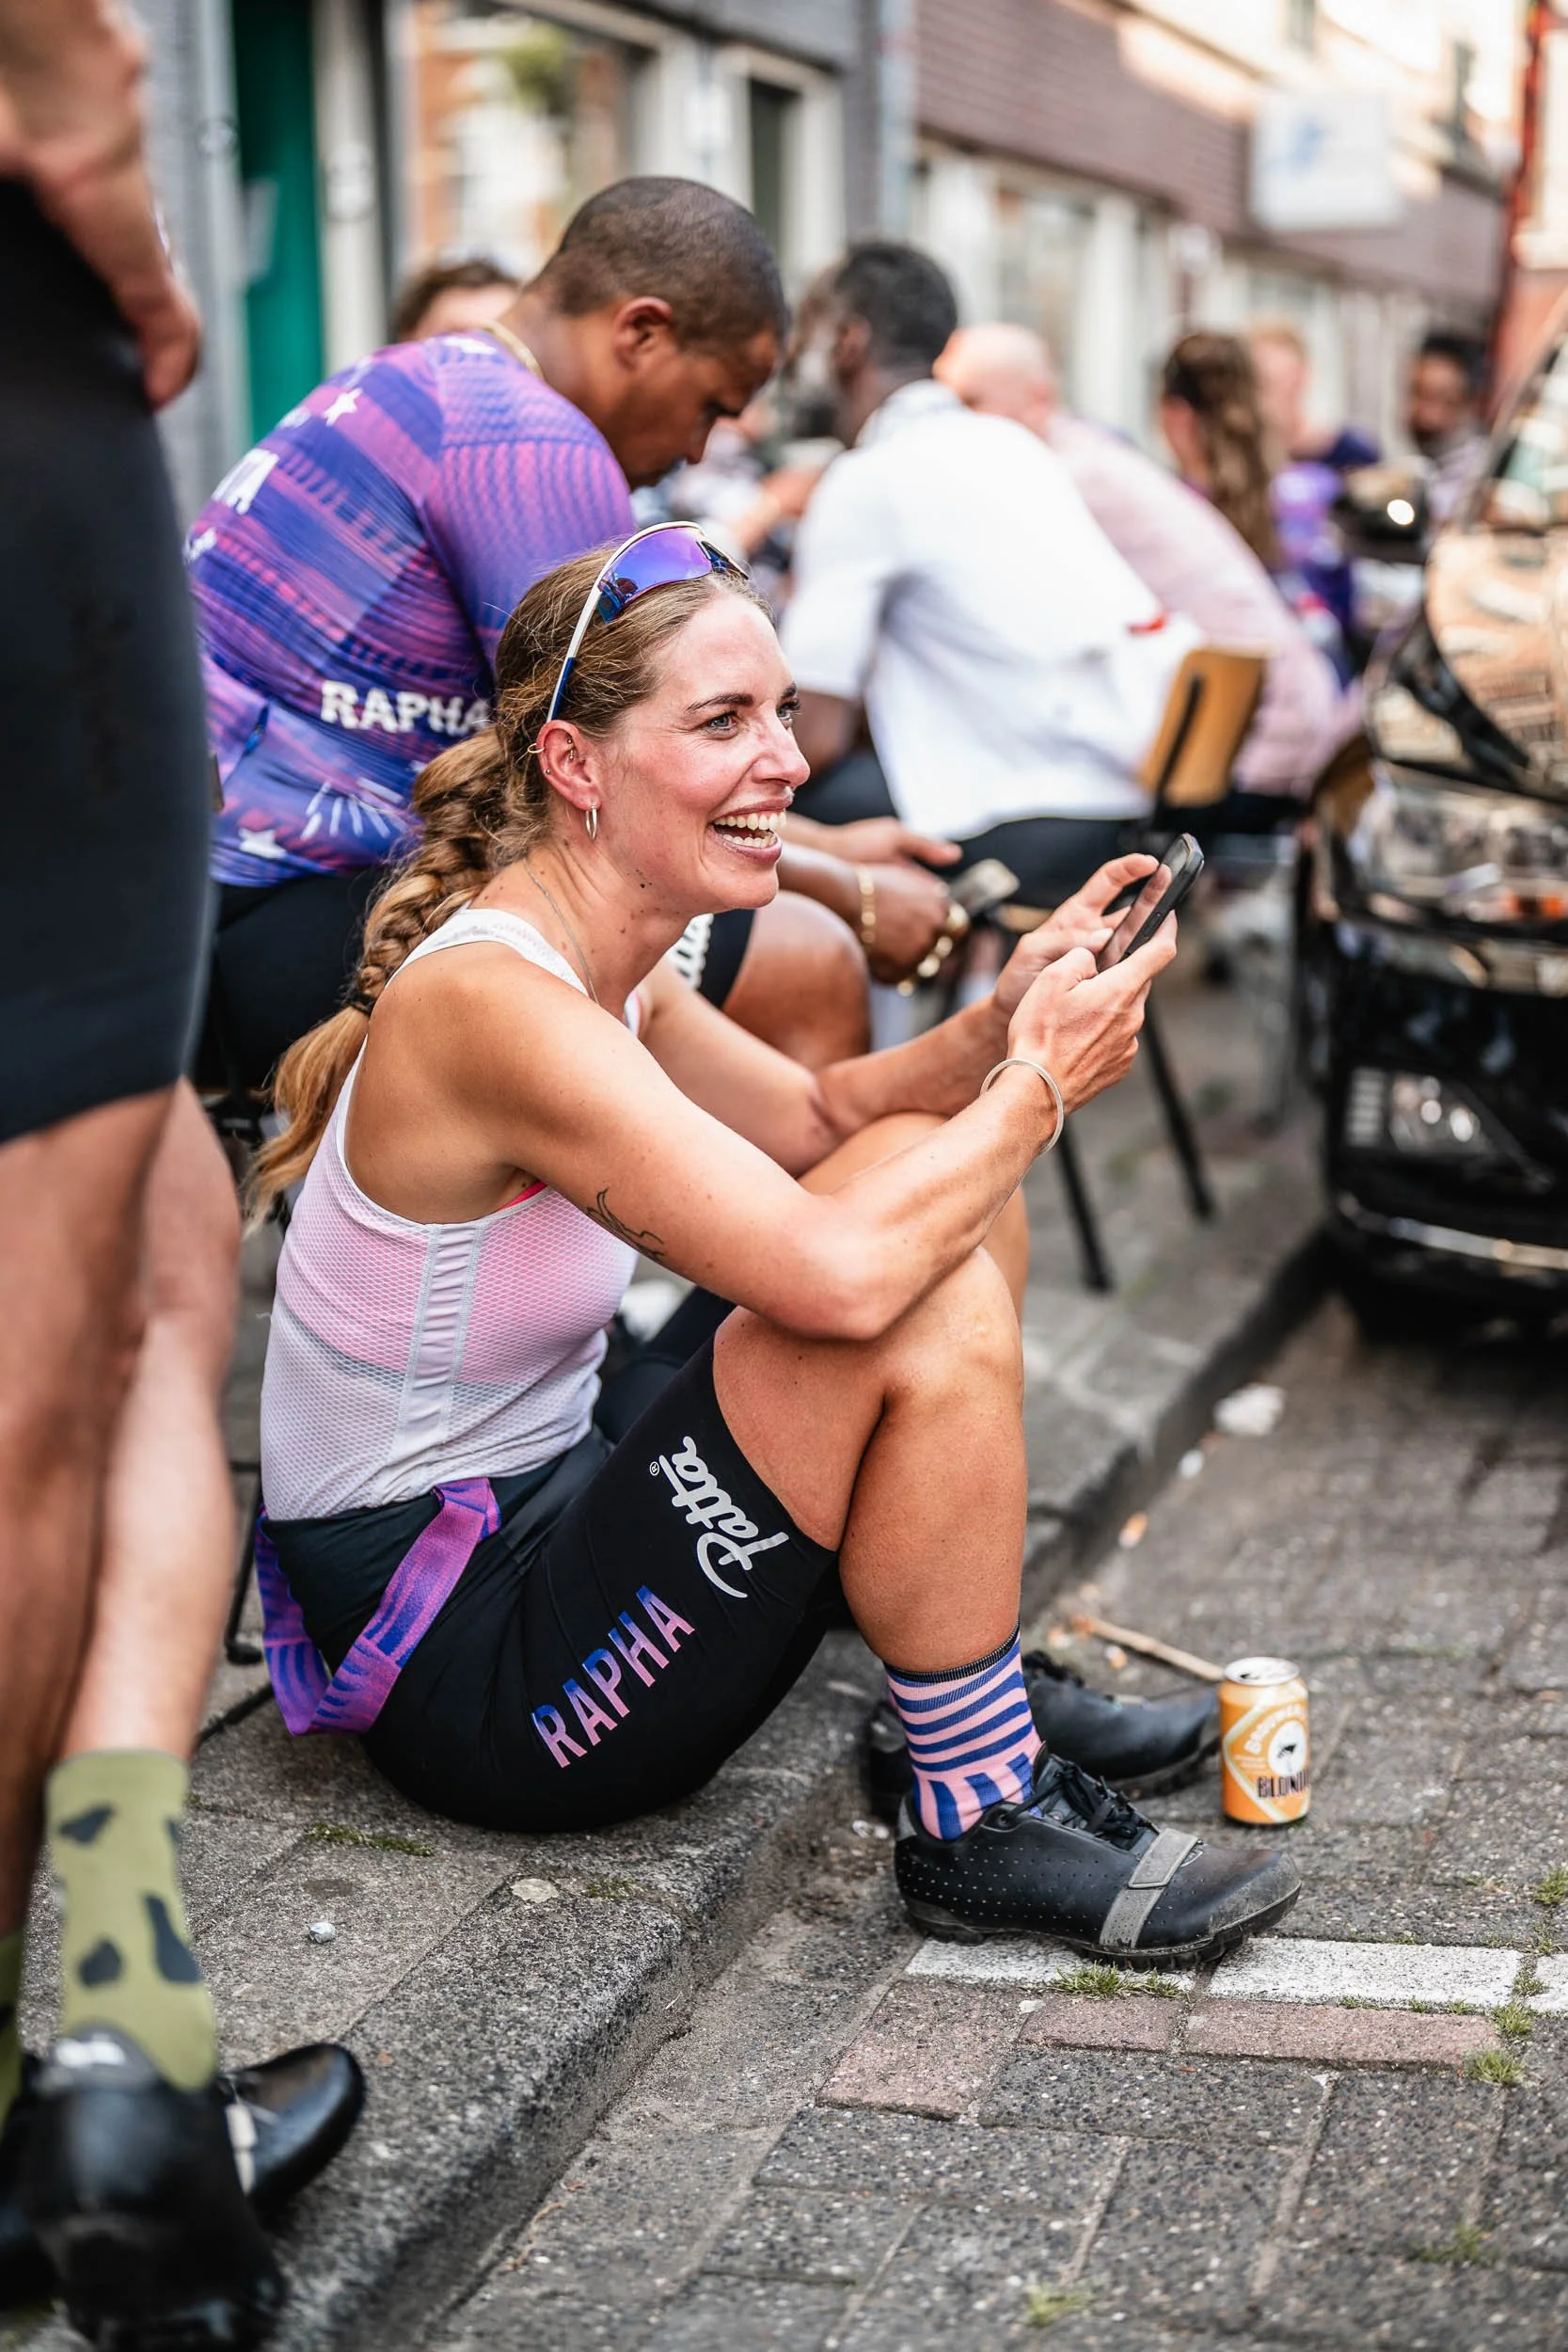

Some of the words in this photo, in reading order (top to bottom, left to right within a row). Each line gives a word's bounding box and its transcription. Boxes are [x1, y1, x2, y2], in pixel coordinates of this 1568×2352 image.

[320, 679, 493, 739] RAPHA
[658, 1436, 789, 1598] Patta
[531, 1584, 696, 1769] RAPHA
